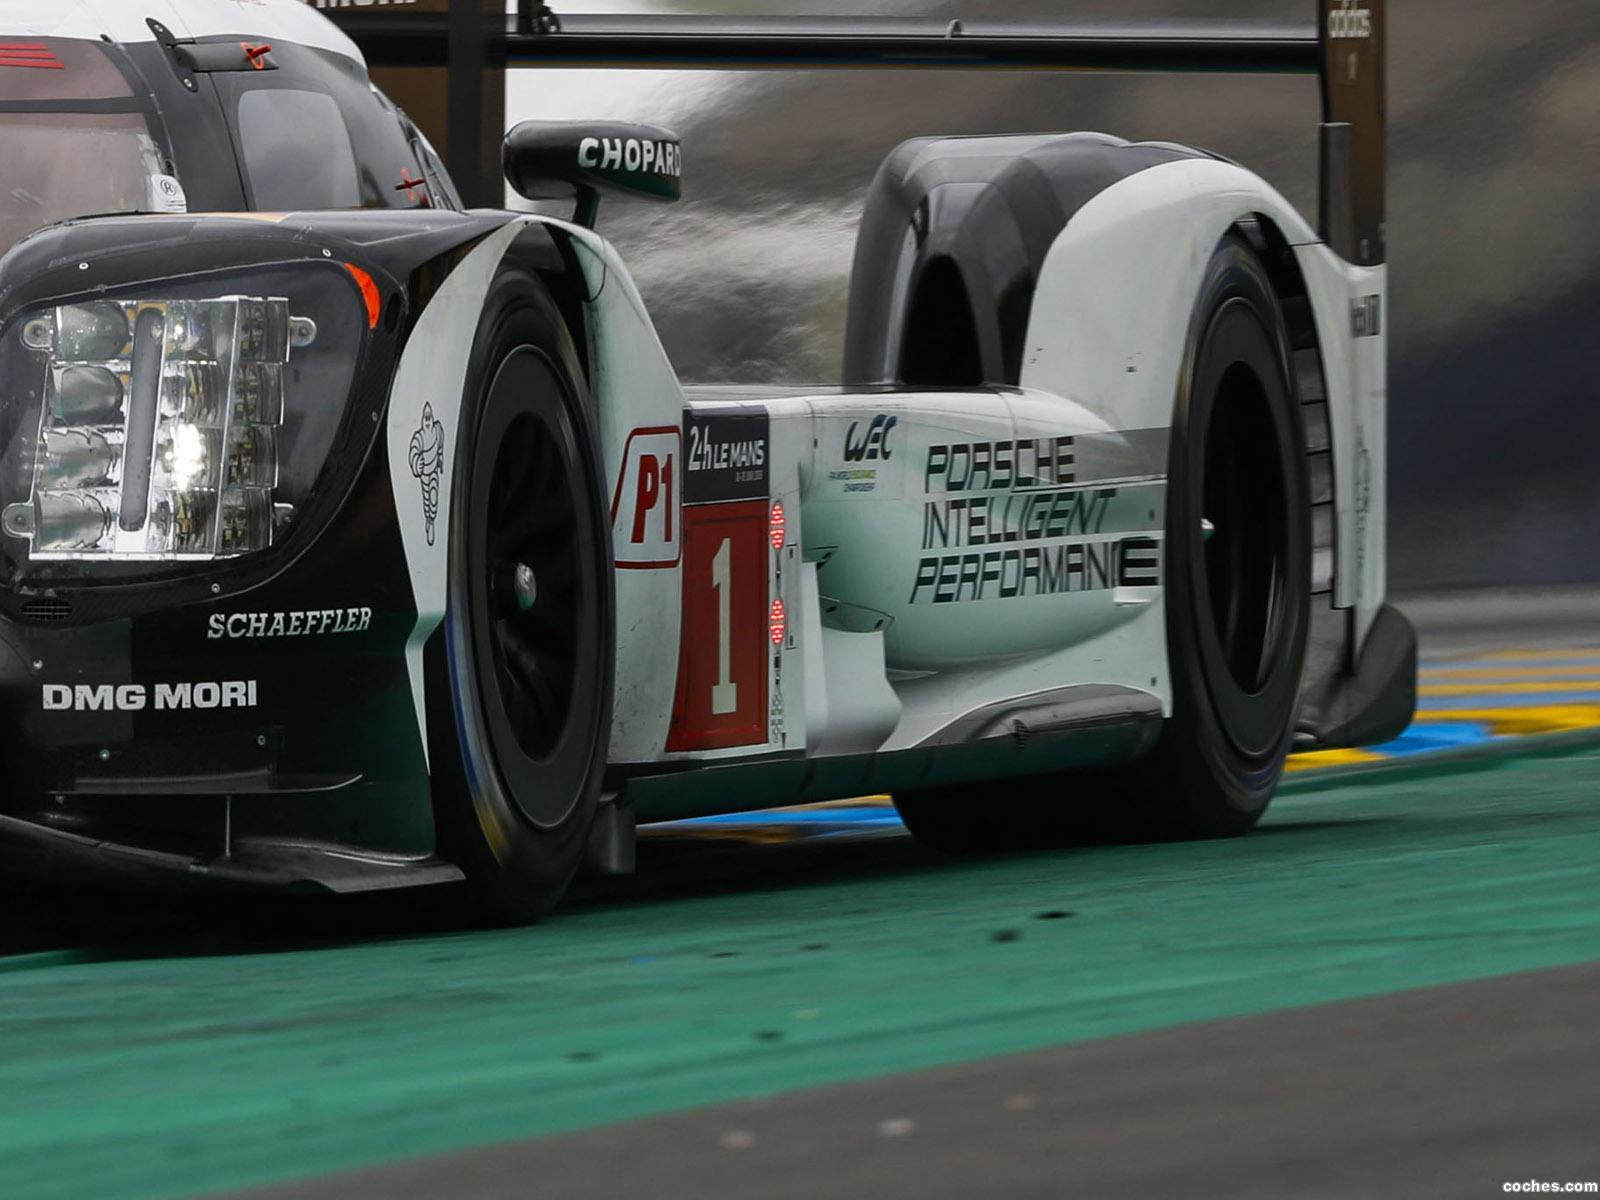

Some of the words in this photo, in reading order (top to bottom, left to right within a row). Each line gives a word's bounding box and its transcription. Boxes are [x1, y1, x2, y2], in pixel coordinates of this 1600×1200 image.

[713, 443, 728, 469] LE
[729, 440, 765, 468] MANS
[843, 414, 897, 462] WEC
[925, 436, 1075, 493] PORSCHE
[631, 453, 673, 543] P1
[922, 488, 1118, 549] INTELLIGENT
[207, 607, 372, 639] SCHAEFFLER
[712, 538, 737, 715] 1
[43, 684, 146, 711] DMG
[154, 680, 258, 710] MORI
